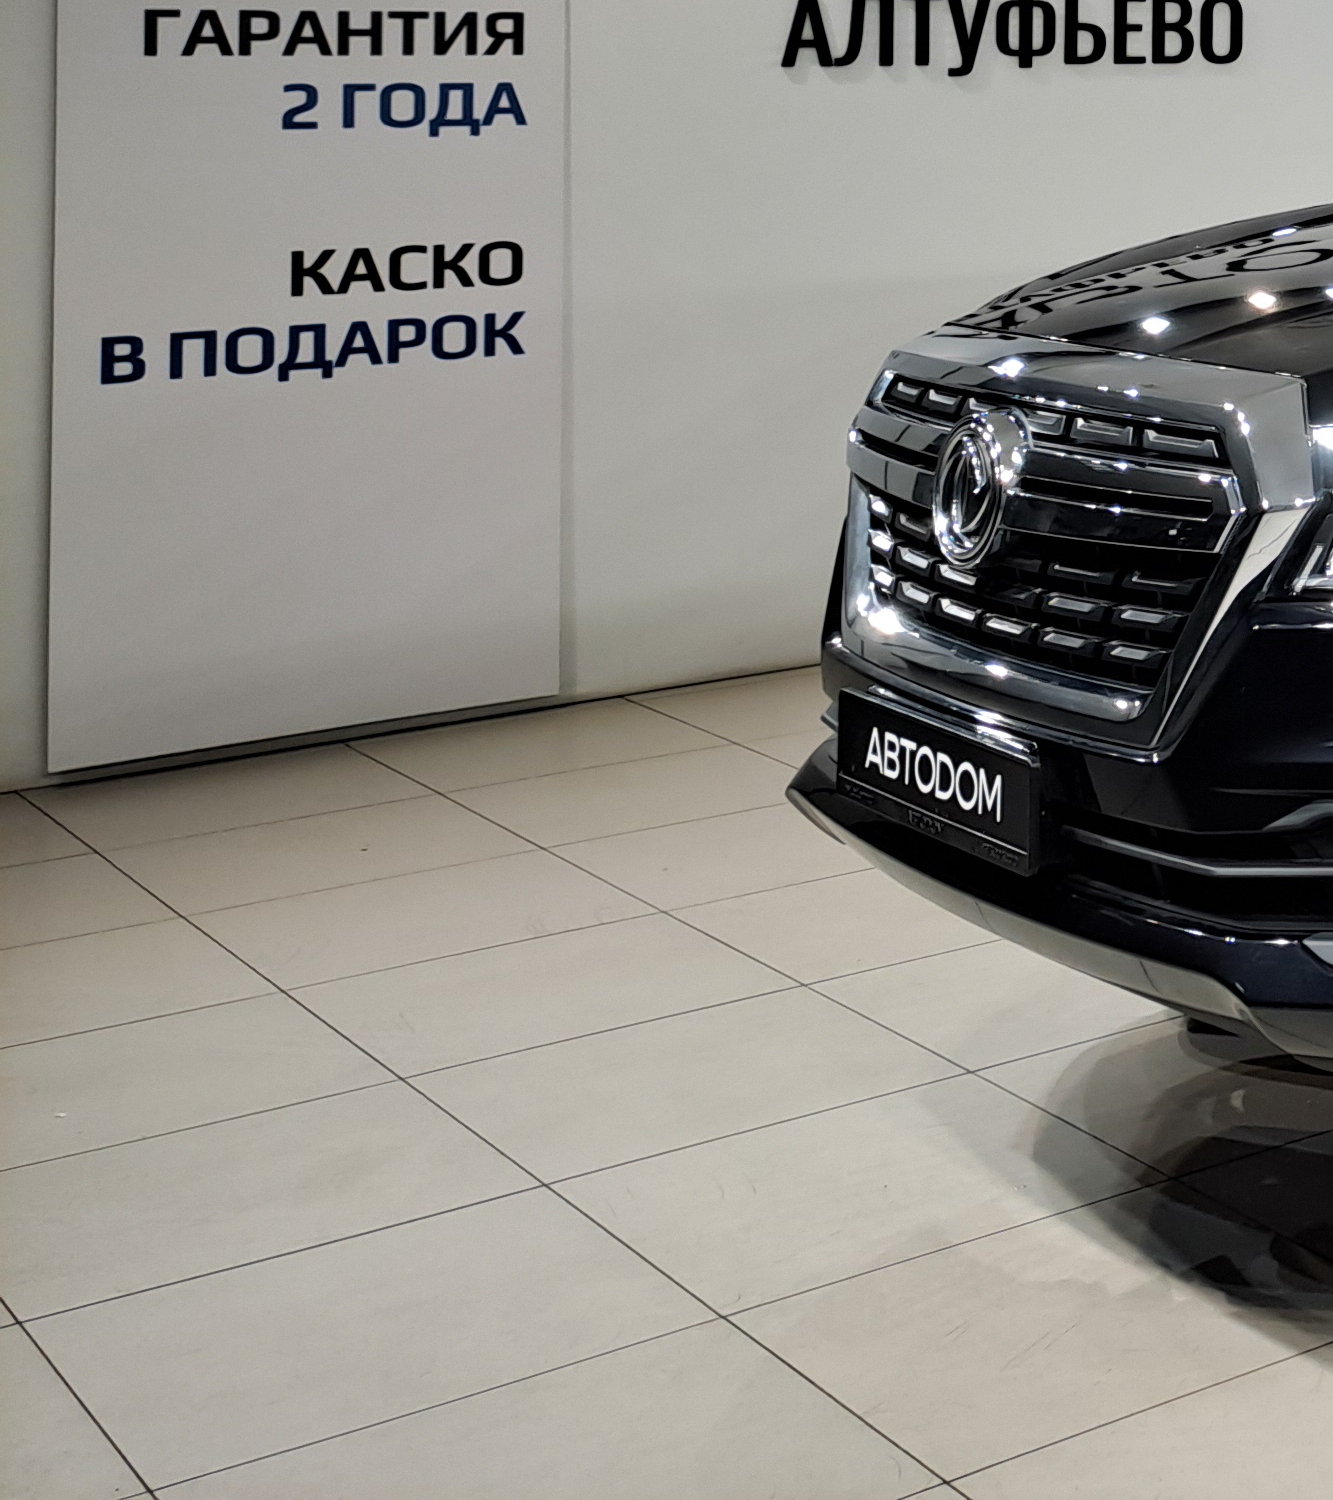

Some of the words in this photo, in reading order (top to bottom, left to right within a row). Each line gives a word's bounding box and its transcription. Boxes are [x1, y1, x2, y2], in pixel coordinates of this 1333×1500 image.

[143, 8, 525, 57] ГАРАНТИЯ
[281, 83, 319, 130] 2
[342, 82, 528, 138] ГОДА
[290, 240, 524, 297] КАСКО
[100, 335, 146, 385] В
[169, 310, 526, 383] ПОДАРОК
